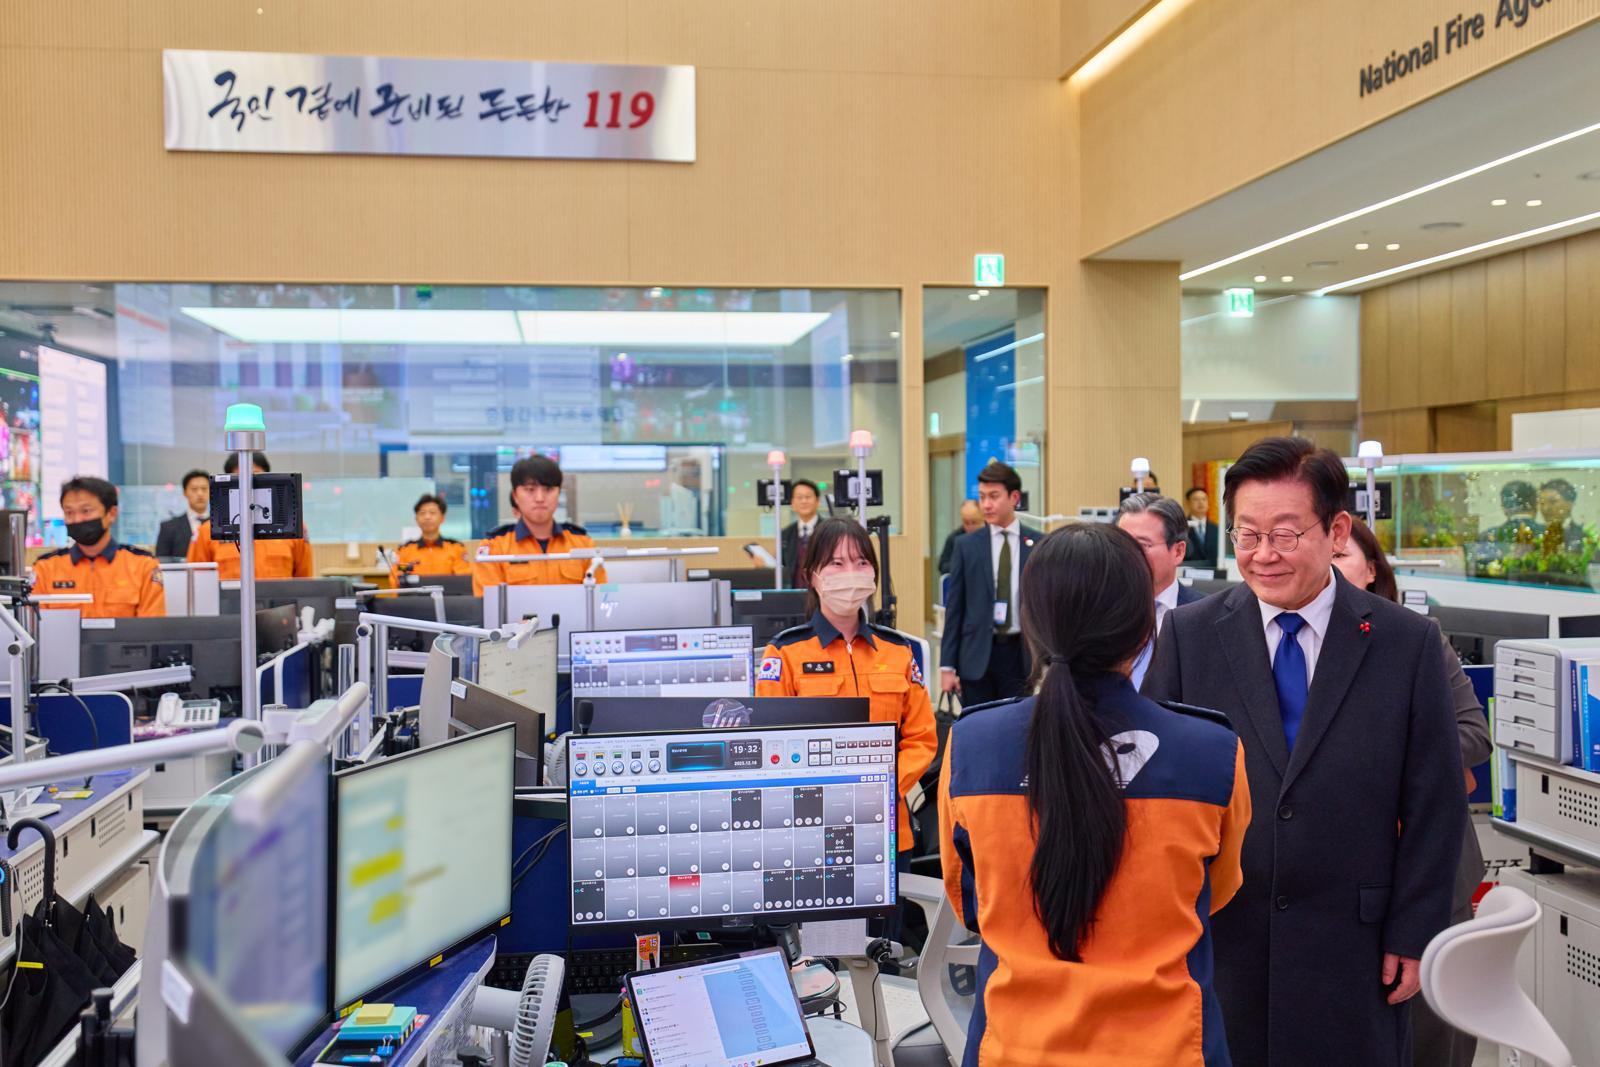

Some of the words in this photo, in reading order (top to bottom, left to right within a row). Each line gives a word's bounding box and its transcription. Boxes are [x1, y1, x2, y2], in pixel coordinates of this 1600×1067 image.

[1359, 26, 1439, 98] National
[1446, 13, 1485, 54] Fire
[208, 70, 275, 132] 국민
[285, 82, 361, 120] 곁에
[369, 83, 465, 124] 완비된
[479, 85, 571, 123] 든든한
[583, 90, 656, 129] 119
